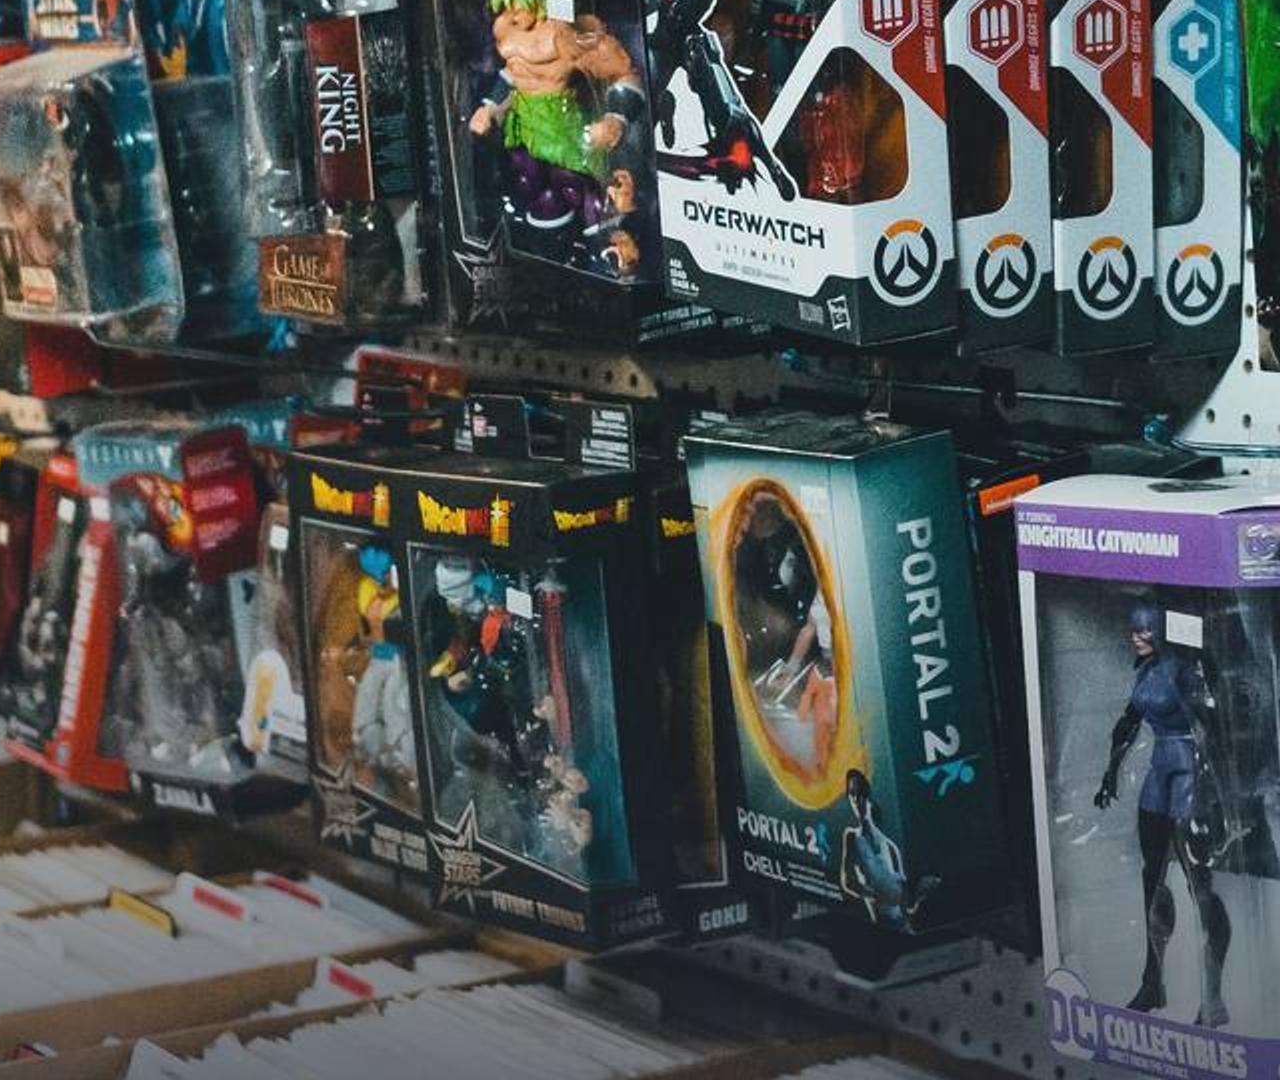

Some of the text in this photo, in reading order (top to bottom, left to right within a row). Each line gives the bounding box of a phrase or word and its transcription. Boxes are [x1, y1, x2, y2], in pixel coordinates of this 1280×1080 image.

[315, 65, 346, 154] KING
[339, 73, 361, 145] NIGHT
[683, 199, 826, 250] OVERWATCH
[273, 243, 320, 281] GAME
[270, 275, 337, 316] THRONES
[1018, 523, 1180, 558] KNIGHTFALL CATWOMAN
[896, 517, 962, 764] PORTAL 2
[736, 805, 820, 855] PORTAL 2
[743, 850, 788, 883] CHELL
[698, 902, 749, 933] GOKU
[1103, 1013, 1249, 1080] COLLECTIBLES
